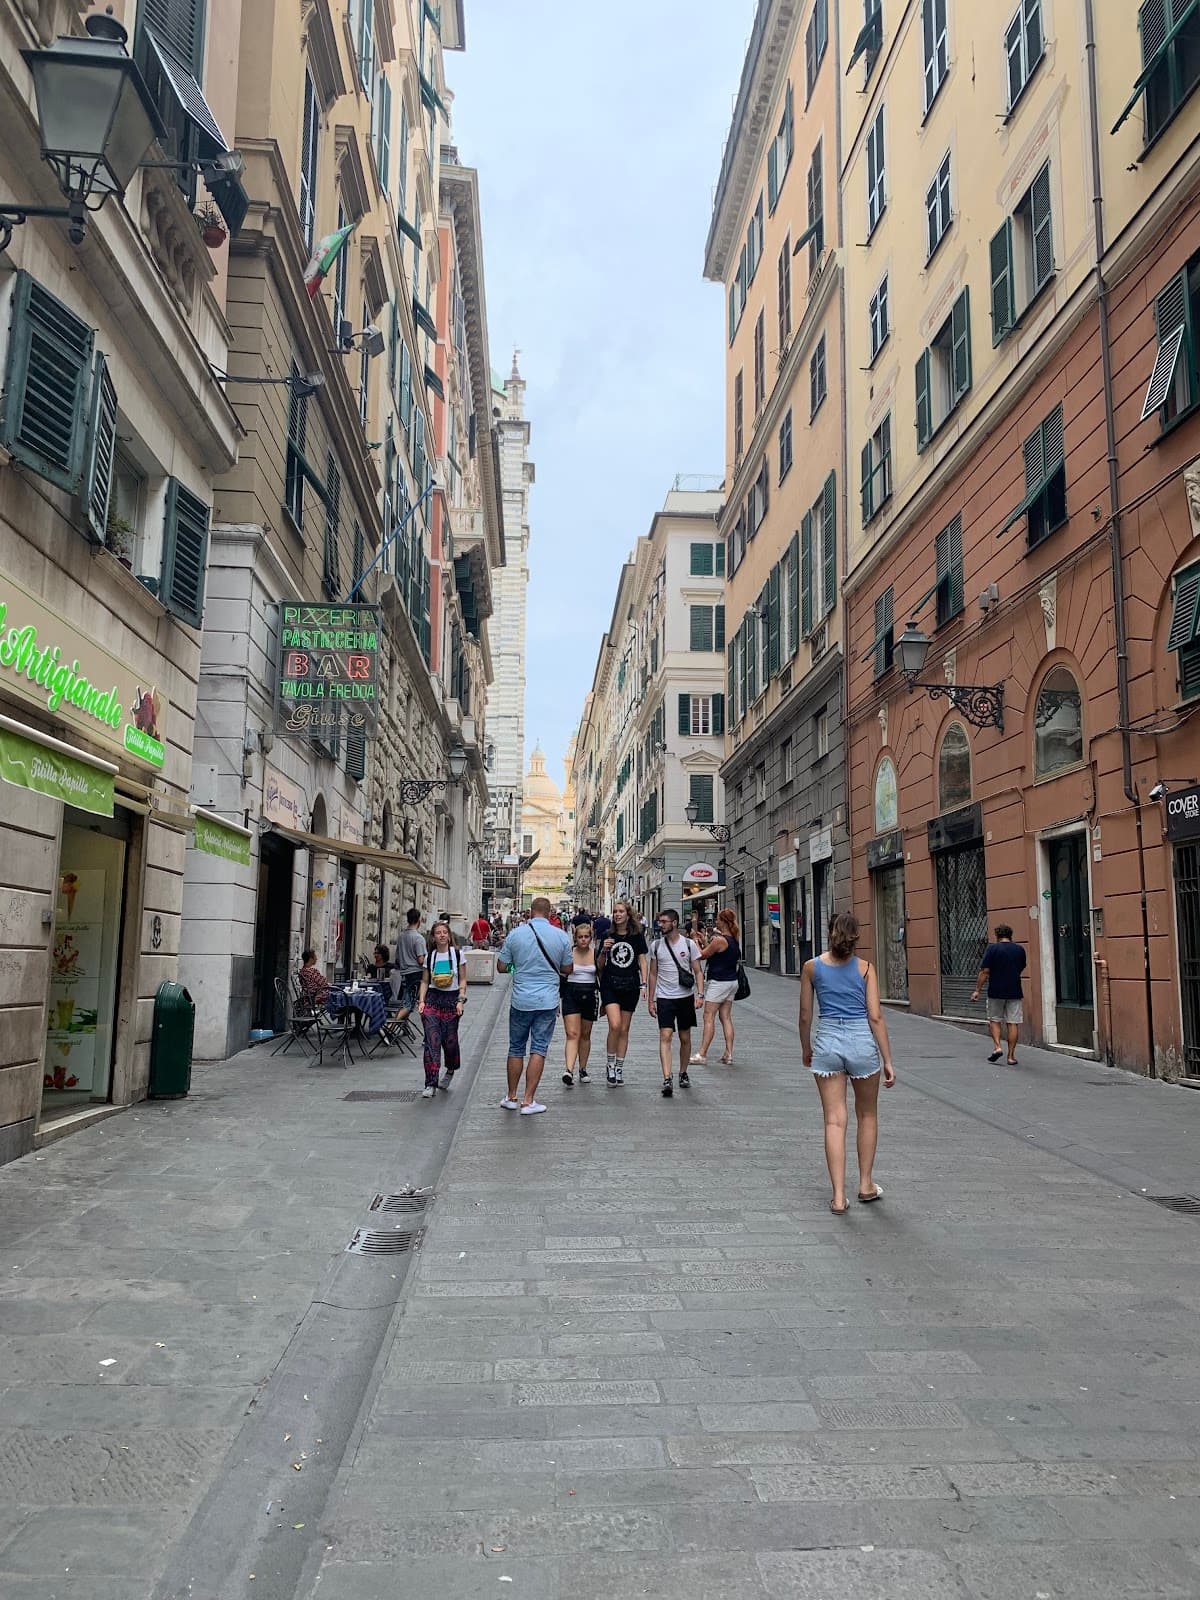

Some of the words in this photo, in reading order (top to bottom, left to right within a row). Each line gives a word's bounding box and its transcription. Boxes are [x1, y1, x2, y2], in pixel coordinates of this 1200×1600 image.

[284, 607, 376, 626] PIZZERIA
[282, 629, 377, 650] PASTICCERIA
[287, 653, 370, 678] BAR
[0, 625, 122, 729] Artigianale
[281, 681, 325, 698] TAVOLA
[329, 682, 375, 699] FREDDA
[1168, 794, 1199, 815] COVER
